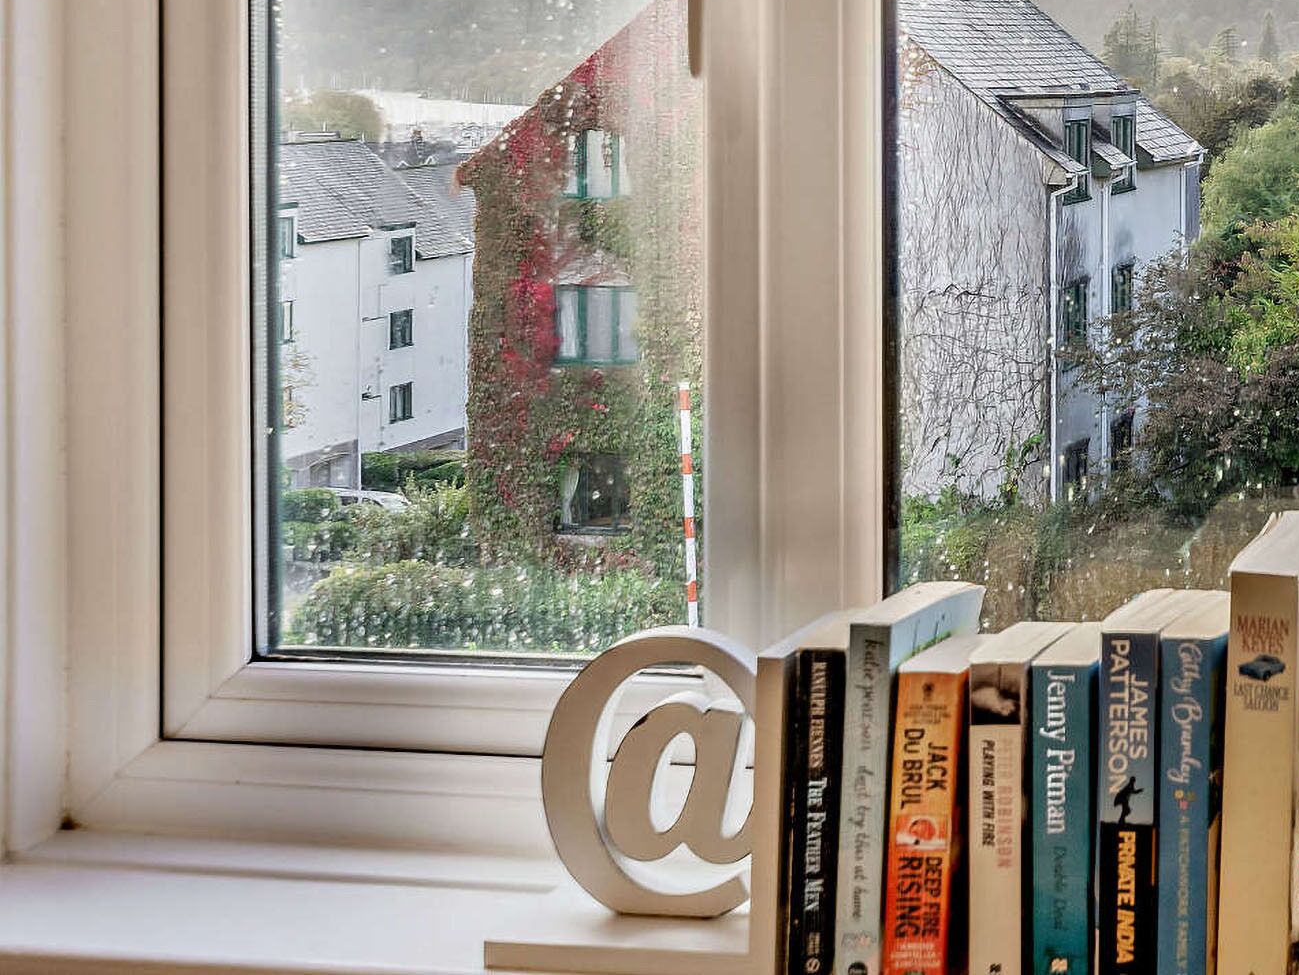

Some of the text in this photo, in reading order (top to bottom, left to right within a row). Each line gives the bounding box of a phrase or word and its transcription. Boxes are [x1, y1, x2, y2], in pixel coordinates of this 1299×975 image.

[1237, 614, 1290, 636] MARIAN
[1241, 634, 1284, 654] KEYES
[809, 719, 826, 769] FIENNES
[1107, 639, 1132, 795] PATTERSON
[1127, 673, 1148, 761] JAMES
[1167, 642, 1204, 784] Cathy Bramley
[901, 759, 925, 810] BRUL
[926, 742, 948, 790] JACK
[1039, 670, 1076, 834] Jenny Pitman
[808, 777, 828, 806] THE
[982, 740, 996, 847] PLAYING WITH FIRE
[997, 785, 1013, 869] ROBINSON
[805, 812, 827, 874] FEATHER
[853, 865, 868, 880] at
[804, 878, 825, 913] MEN
[895, 857, 923, 938] RISING
[921, 857, 943, 938] DEEP FIRE
[1116, 831, 1137, 964] PRIVATE INDIA
